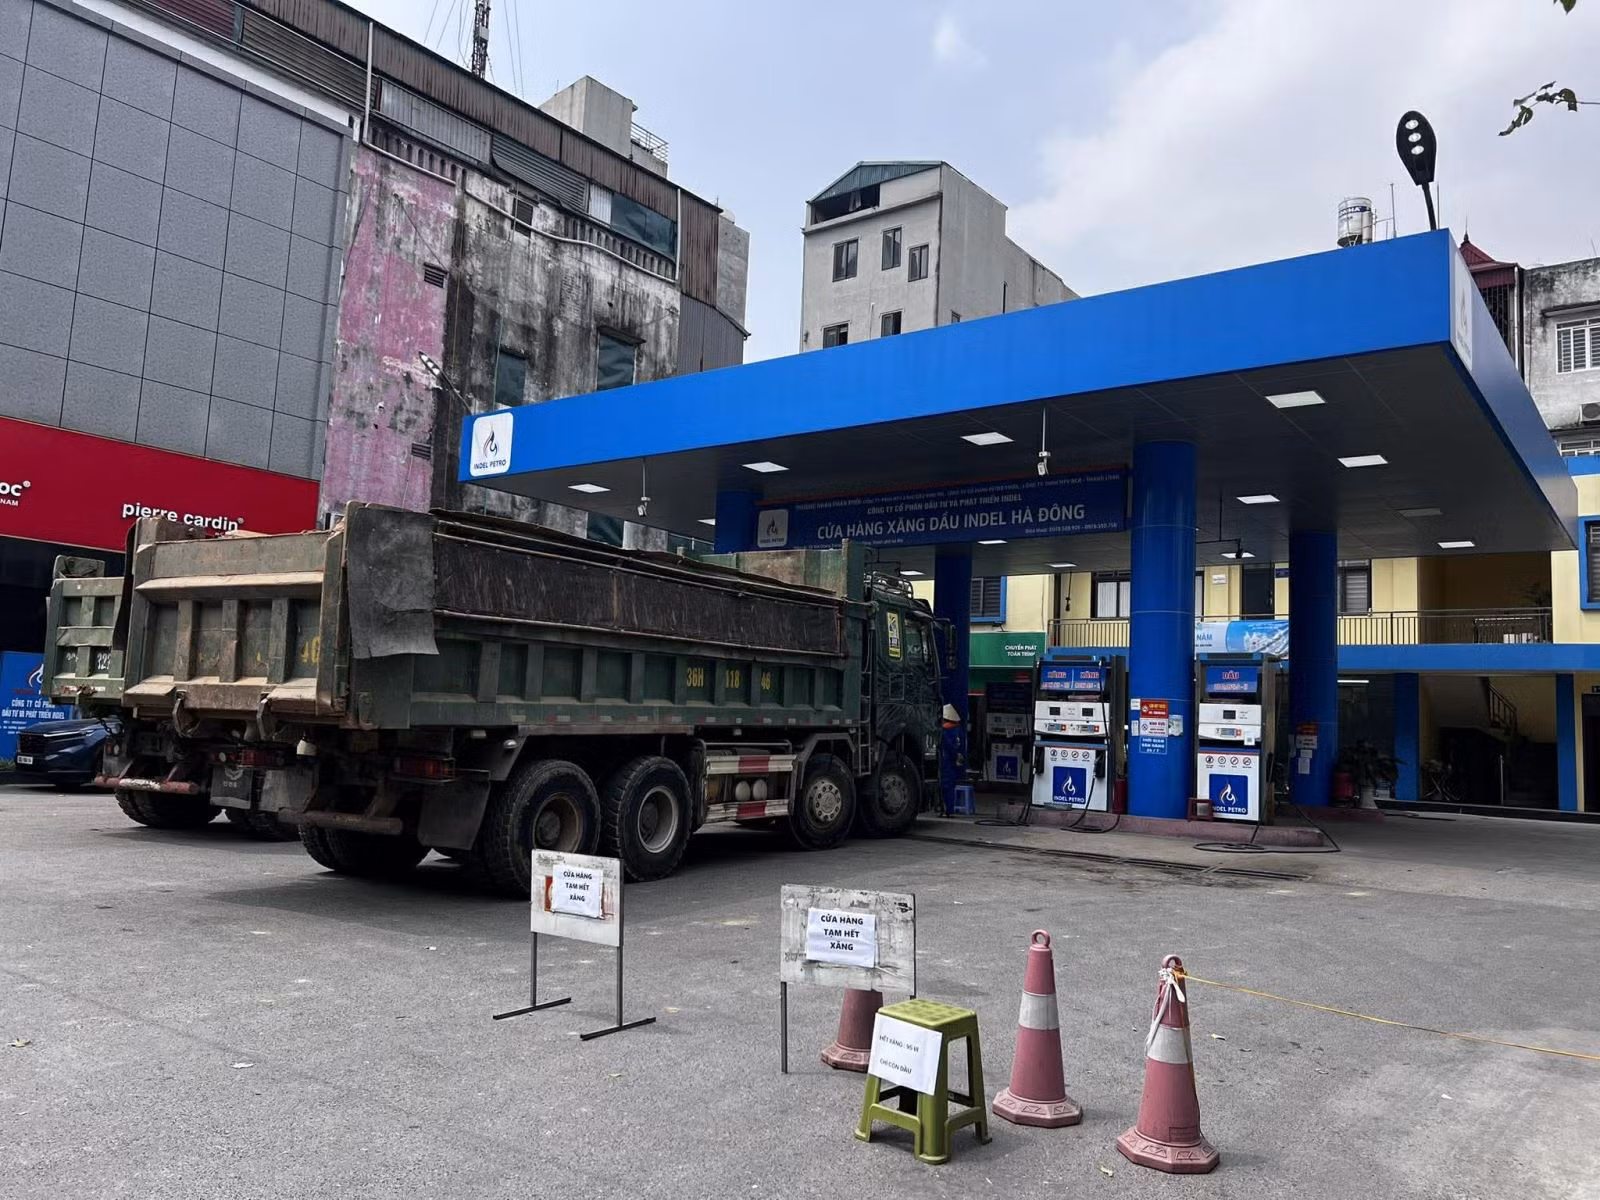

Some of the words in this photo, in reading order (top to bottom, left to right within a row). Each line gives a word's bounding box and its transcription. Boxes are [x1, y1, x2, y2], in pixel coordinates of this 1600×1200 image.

[490, 459, 507, 468] PETRO
[867, 506, 884, 515] CÔNG
[886, 505, 894, 514] TY
[959, 496, 977, 506] PHÁT
[122, 502, 178, 523] pierre
[183, 512, 238, 532] cardin
[817, 522, 843, 540] CỬA
[847, 520, 883, 537] HÀNG
[887, 517, 925, 533] XĂNG
[929, 511, 959, 531] DẦU
[964, 511, 1006, 528] INDEL
[1011, 505, 1034, 525] HÀ
[1038, 503, 1085, 522] ĐÔNG
[686, 667, 704, 687] 36H
[725, 669, 740, 689] 118
[1228, 806, 1247, 814] PETRO
[563, 868, 575, 878] CỬA
[575, 870, 592, 880] HÀNG
[578, 883, 590, 891] HẾT
[569, 893, 585, 902] XĂNG
[820, 913, 838, 923] CỬA
[839, 915, 864, 925] HÀNG
[824, 928, 842, 938] TẠM
[844, 929, 860, 938] HẾT
[830, 941, 854, 951] XĂNG
[888, 1061, 900, 1071] CÒN
